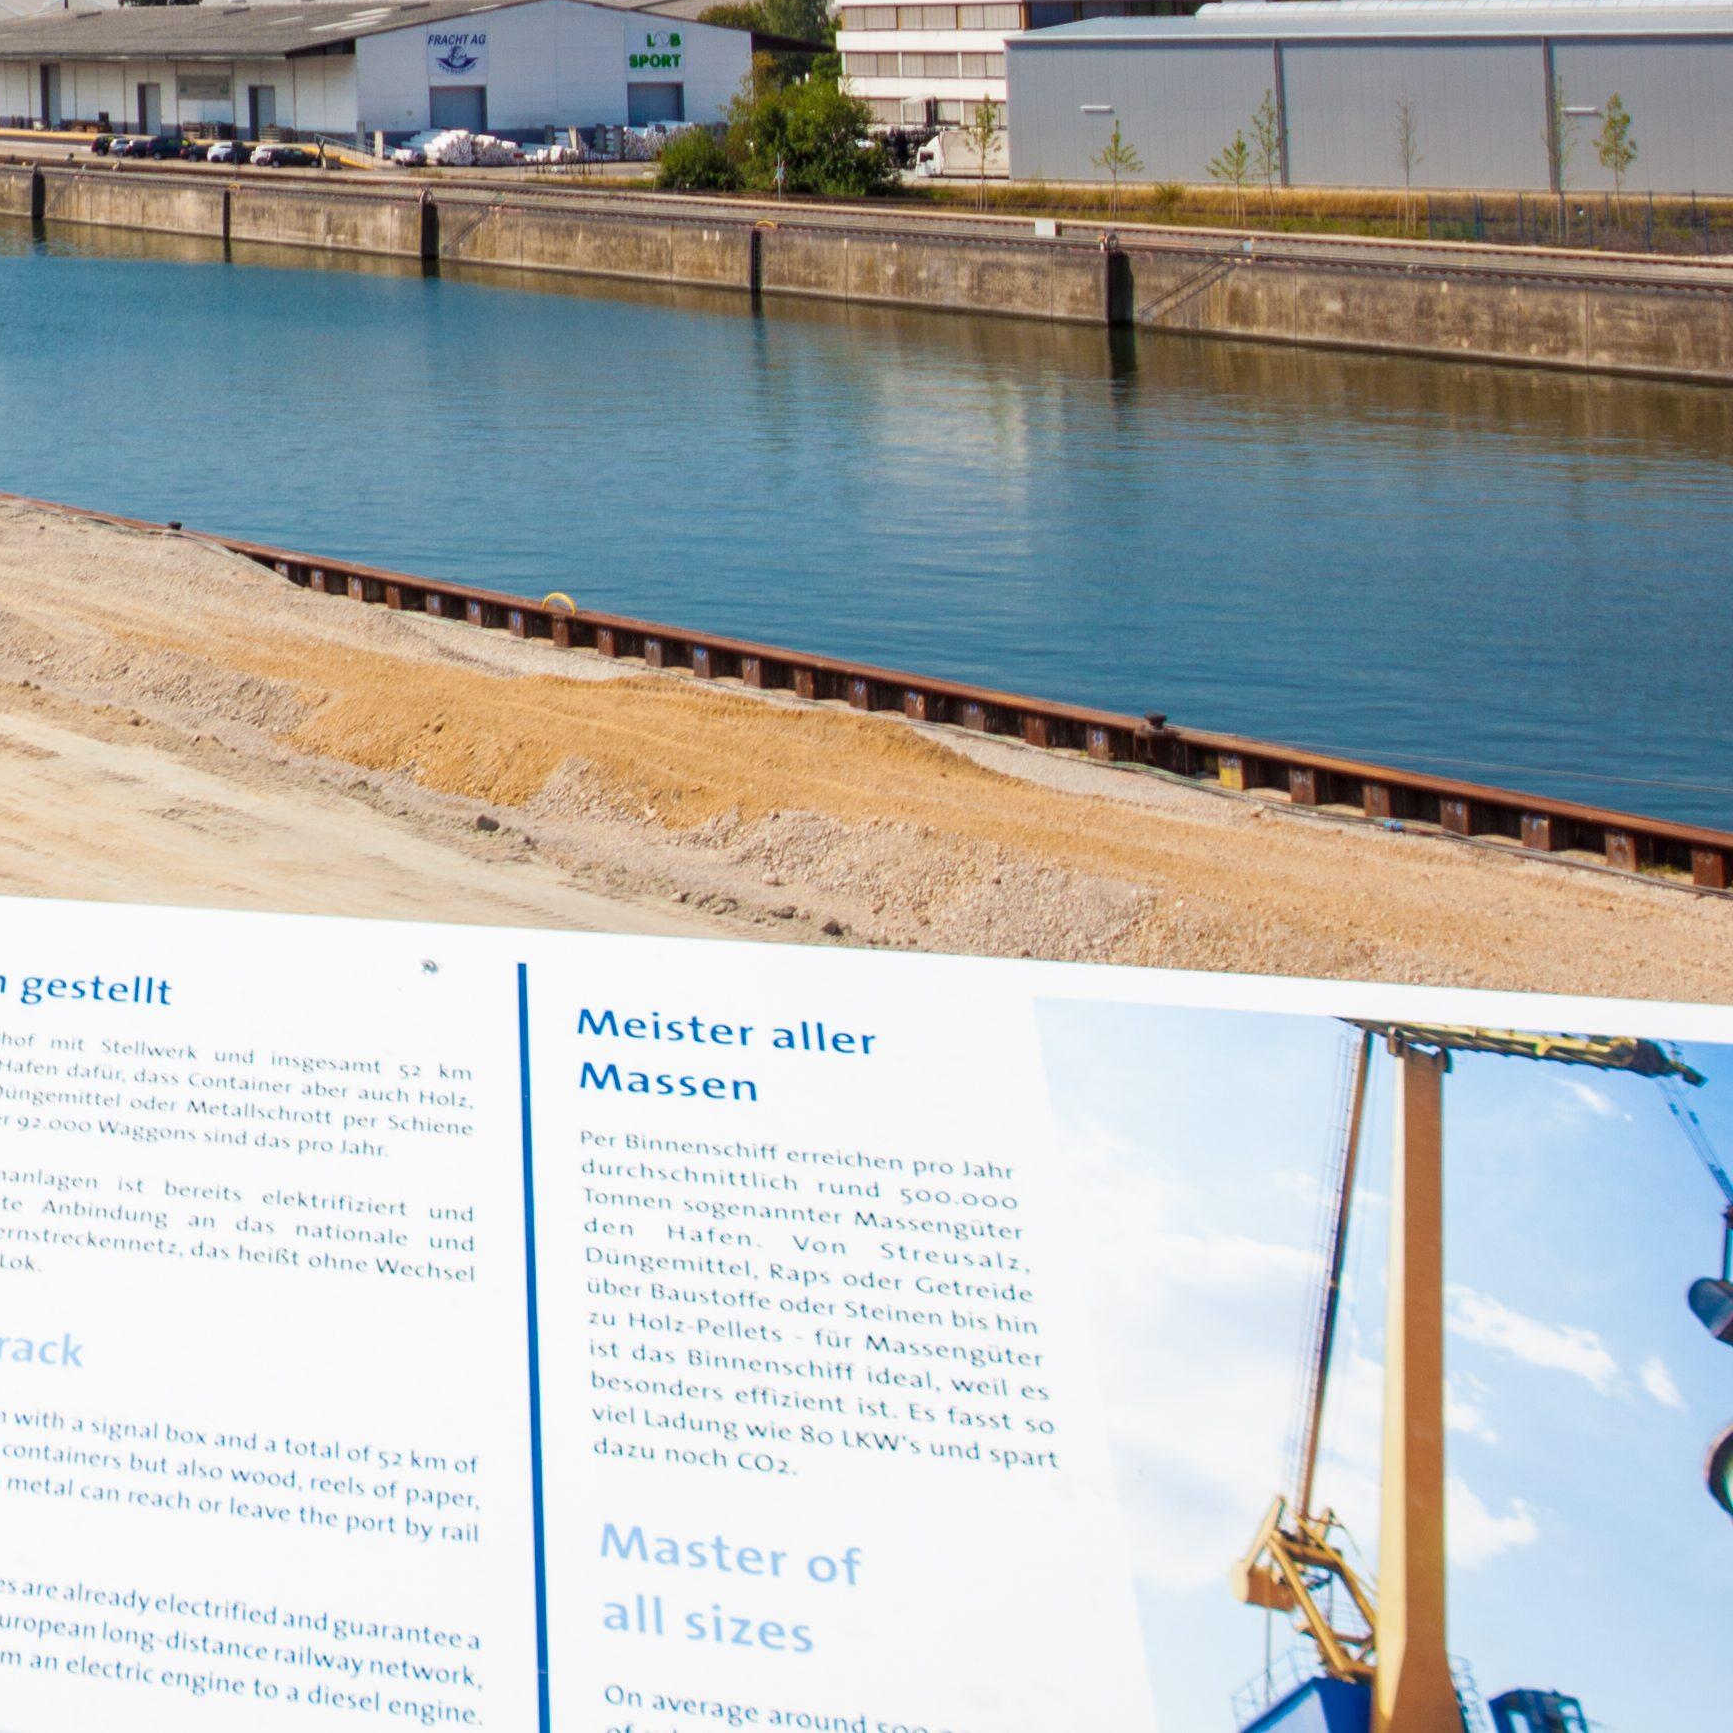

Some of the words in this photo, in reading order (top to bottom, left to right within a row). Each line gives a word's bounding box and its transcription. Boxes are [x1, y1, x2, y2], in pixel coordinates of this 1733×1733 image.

[428, 34, 469, 46] FRACHT
[470, 34, 486, 45] AG
[629, 54, 681, 68] SPORT
[20, 975, 172, 1006] gestellt
[577, 1008, 754, 1047] Meister
[772, 1020, 877, 1056] aller
[49, 1036, 86, 1053] mit
[100, 1037, 198, 1062] Stellwerk
[214, 1048, 255, 1068] und
[269, 1049, 382, 1076] insgesamt
[397, 1063, 422, 1082] 52
[436, 1062, 474, 1083] km
[579, 1061, 758, 1102] Massen
[65, 1061, 128, 1085] dafür,
[132, 1065, 181, 1087] dass
[186, 1071, 294, 1099] Container
[300, 1079, 350, 1099] aber
[356, 1082, 412, 1106] auch
[417, 1088, 475, 1112] Holz,
[16, 1113, 94, 1135] 92.000
[97, 1117, 198, 1145] Waggons
[202, 1126, 250, 1147] sind
[252, 1130, 292, 1151] das
[296, 1137, 334, 1157] pro
[338, 1138, 390, 1163] Jahr.
[125, 1094, 178, 1115] oder
[184, 1097, 333, 1128] Metallschrott
[342, 1113, 379, 1133] per
[386, 1113, 476, 1137] Schiene
[581, 1130, 617, 1147] Per
[625, 1133, 778, 1161] Binnenschiff
[786, 1150, 904, 1172] erreichen
[912, 1161, 954, 1178] pro
[963, 1161, 1013, 1180] Jahr
[581, 1158, 799, 1192] durchschnittlich
[818, 1181, 881, 1199] rund
[900, 1188, 1019, 1210] 500.000
[583, 1187, 672, 1210] Tonnen
[683, 1199, 841, 1226] sogenannter
[854, 1210, 1023, 1242] Massengüter
[584, 1217, 634, 1237] den
[667, 1224, 761, 1248] Hafen.
[792, 1235, 847, 1256] Von
[878, 1242, 1030, 1274] Streusalz,
[585, 1246, 759, 1281] Düngemittel,
[769, 1263, 831, 1288] Raps
[842, 1270, 903, 1290] oder
[915, 1274, 1033, 1303] Getreide
[587, 1277, 642, 1298] über
[651, 1282, 771, 1311] Baustoffe
[779, 1296, 836, 1316] oder
[844, 1300, 944, 1326] Steinen
[950, 1309, 989, 1331] bis
[996, 1314, 1039, 1335] hin
[588, 1311, 617, 1328] zu
[629, 1312, 783, 1343] Holz-Pellets
[814, 1328, 853, 1350] für
[864, 1334, 1044, 1368] Massengüter
[590, 1339, 619, 1360] ist
[630, 1343, 675, 1365] das
[687, 1349, 854, 1382] Binnenschiff
[867, 1366, 941, 1394] ideal,
[950, 1378, 1008, 1397] weil
[1020, 1385, 1049, 1402] es
[591, 1370, 725, 1401] besonders
[734, 1386, 846, 1414] effizient
[858, 1397, 898, 1419] ist.
[909, 1402, 937, 1423] Es
[947, 1405, 1013, 1431] fasst
[1023, 1418, 1056, 1434] so
[592, 1404, 636, 1425] viel
[644, 1409, 742, 1442] Ladung
[745, 1421, 793, 1442] wie
[800, 1424, 834, 1446] 80
[842, 1429, 921, 1455] LKW's
[930, 1440, 981, 1461] und
[989, 1449, 1060, 1471] spart
[592, 1435, 655, 1462] dazu
[665, 1448, 729, 1468] noch
[736, 1451, 797, 1475] CO2.
[599, 1521, 789, 1578] Master
[806, 1546, 864, 1588] of
[603, 1593, 664, 1636] all
[684, 1603, 814, 1654] sizes
[28, 1652, 64, 1674] an
[64, 1651, 155, 1687] electric
[157, 1668, 246, 1699] engine
[248, 1673, 281, 1701] to
[284, 1684, 302, 1707] a
[305, 1681, 382, 1714] diesel
[386, 1697, 484, 1728] engine.
[605, 1684, 642, 1707] On
[652, 1693, 758, 1726] average
[768, 1707, 865, 1732] around
